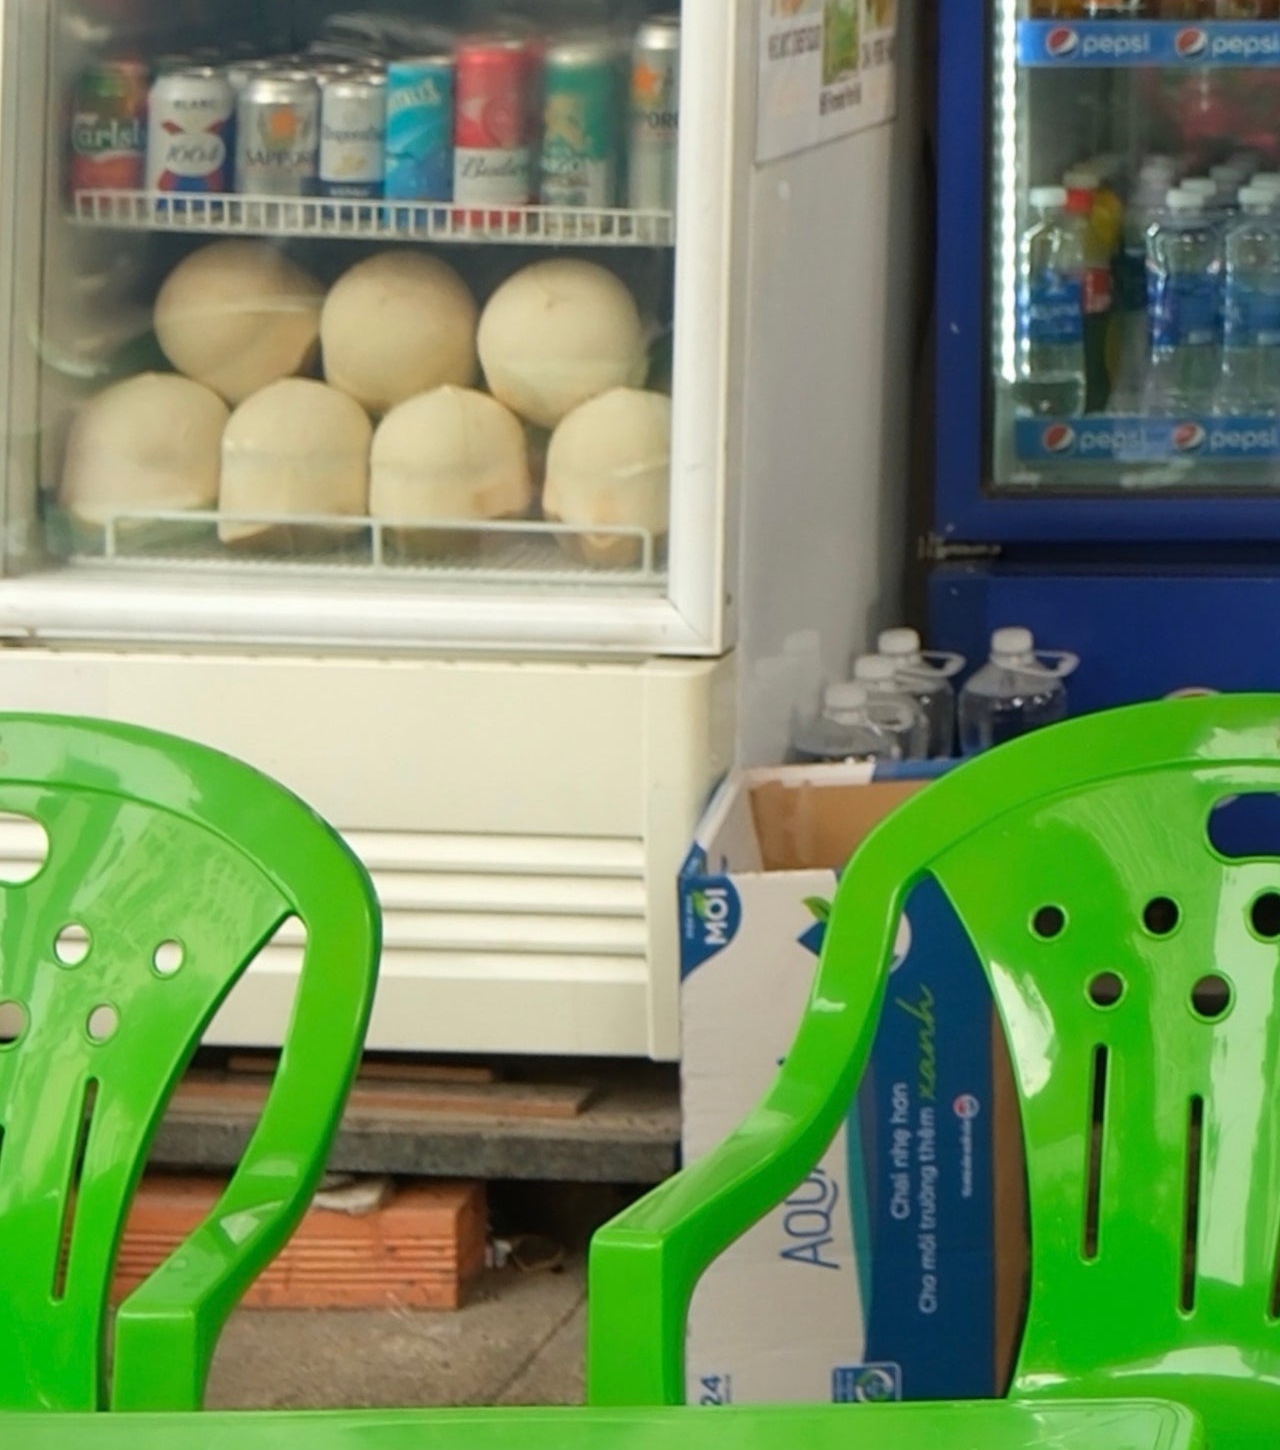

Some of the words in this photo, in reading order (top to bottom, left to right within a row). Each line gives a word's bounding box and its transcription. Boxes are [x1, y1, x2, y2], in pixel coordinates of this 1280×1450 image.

[1083, 32, 1149, 57] pepsi
[1212, 33, 1280, 58] pepsi
[1210, 428, 1278, 451] pepsi
[895, 980, 937, 1101] xanh
[916, 1106, 938, 1162] thêm
[889, 1172, 911, 1220] Chai
[916, 1234, 938, 1270] môi
[917, 1274, 938, 1314] Cho
